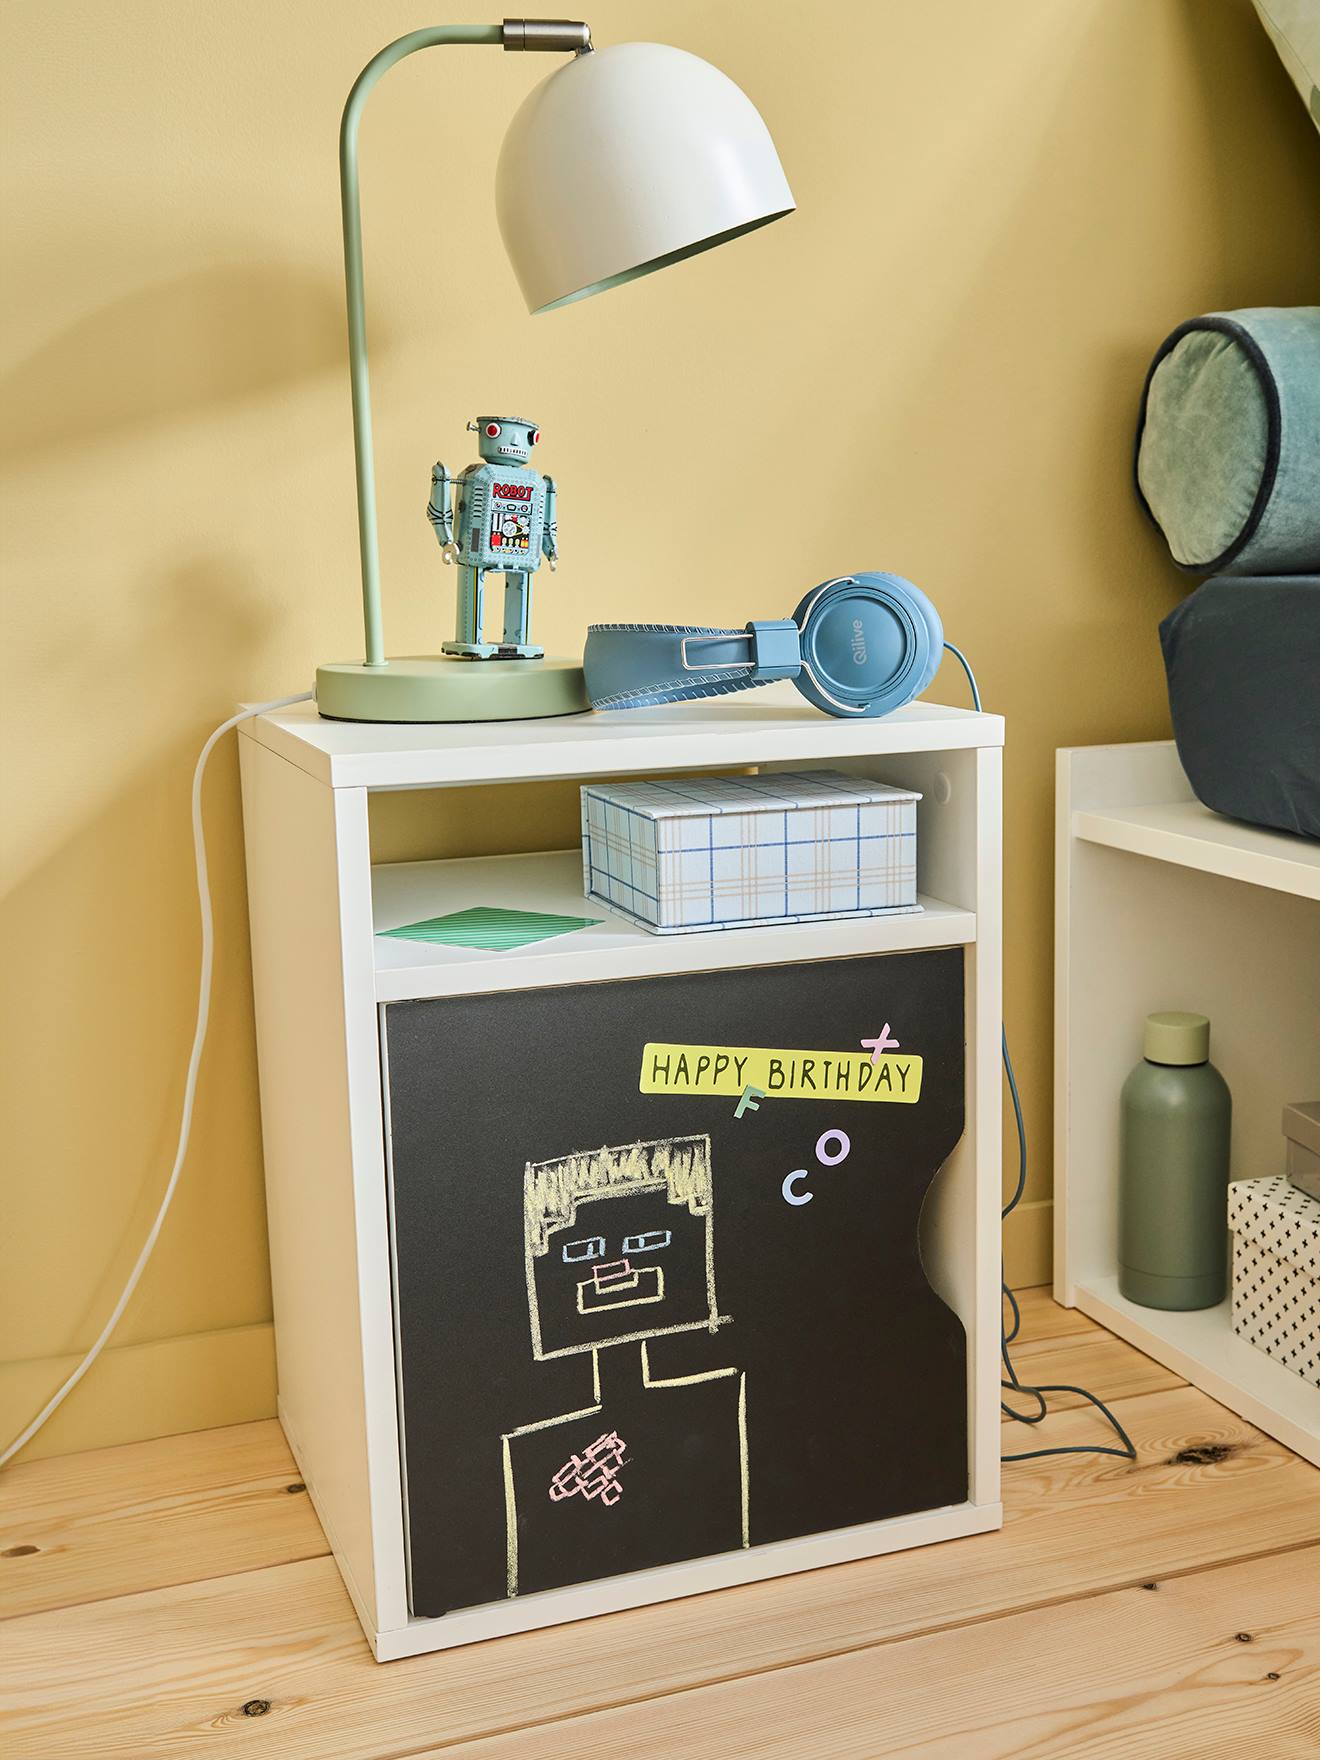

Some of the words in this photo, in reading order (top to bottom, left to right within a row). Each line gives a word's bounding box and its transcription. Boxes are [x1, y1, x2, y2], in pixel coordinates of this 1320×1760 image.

[492, 482, 534, 501] ROBOT
[850, 619, 867, 665] Qilive
[652, 1053, 748, 1087] HAPPY
[767, 1058, 911, 1093] BIRTHDAY
[733, 1084, 766, 1119] F
[815, 1129, 850, 1166] O
[781, 1169, 814, 1206] C
